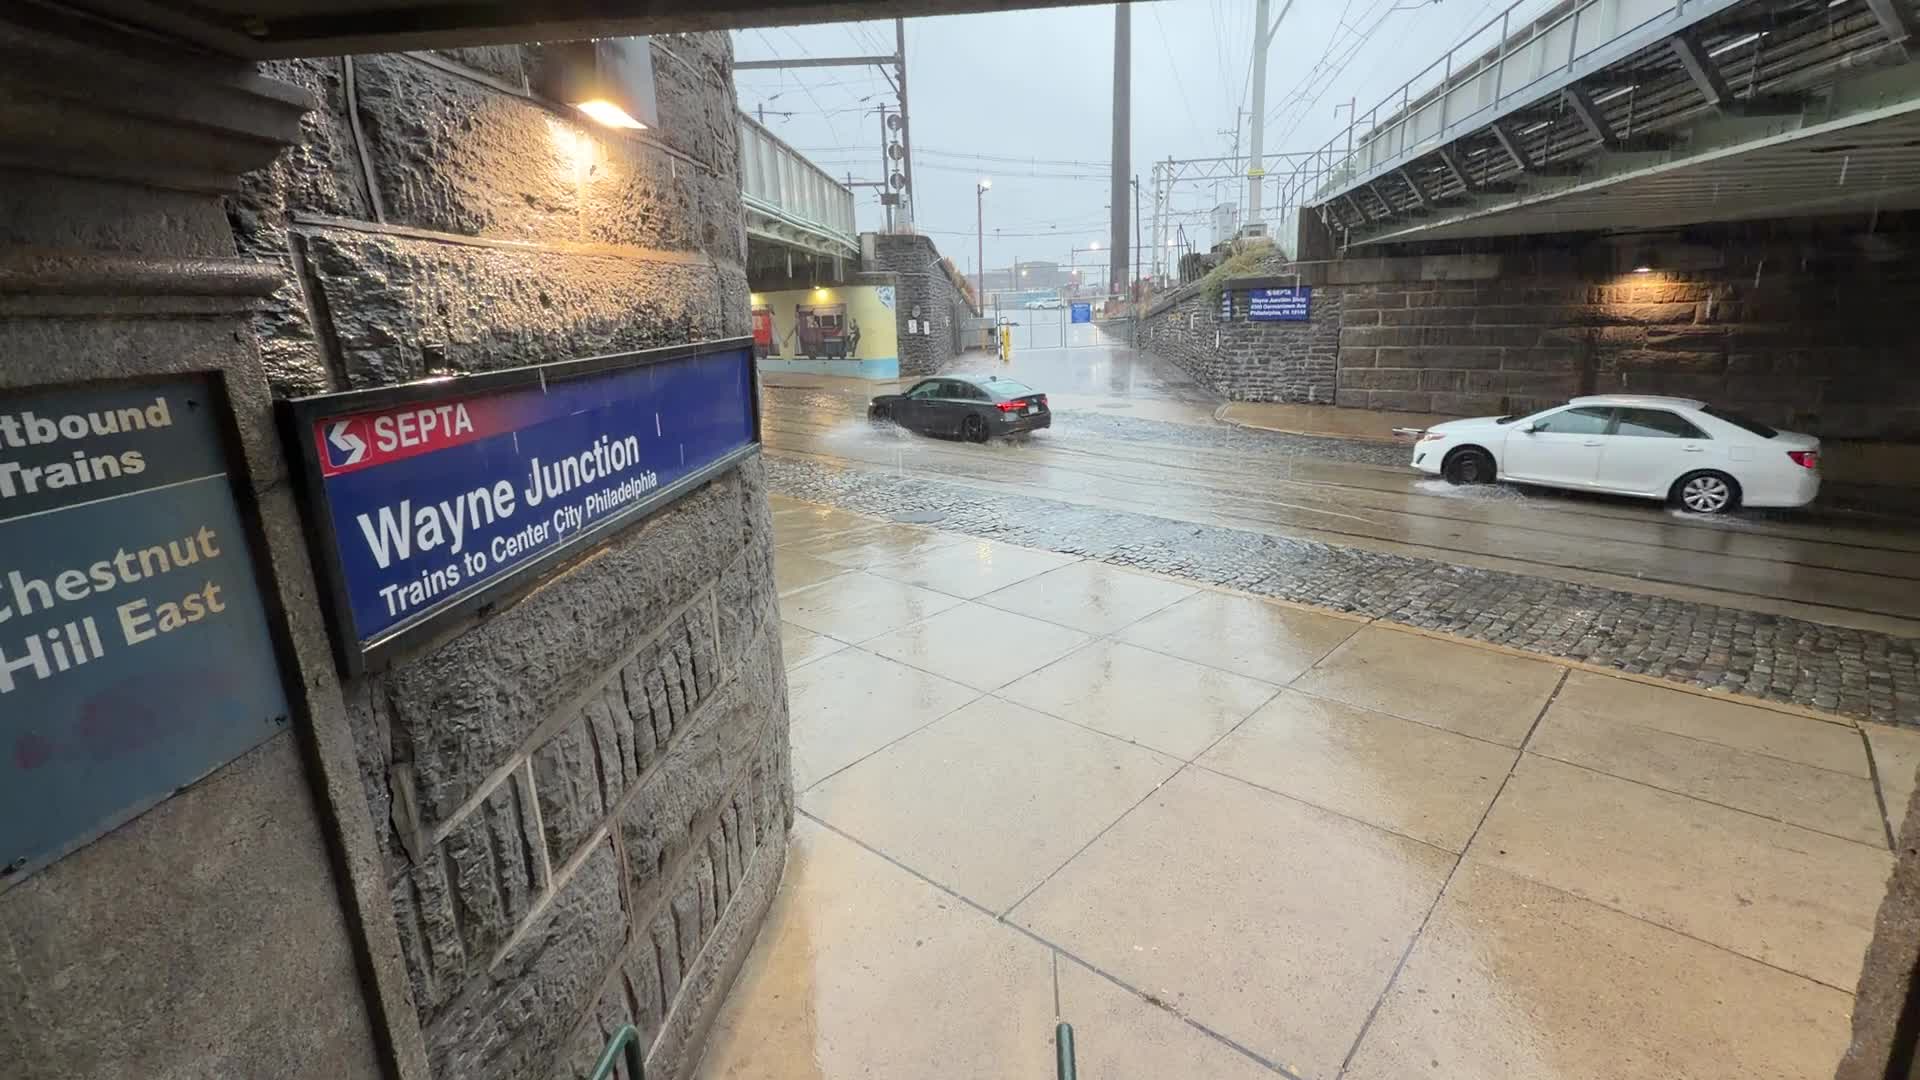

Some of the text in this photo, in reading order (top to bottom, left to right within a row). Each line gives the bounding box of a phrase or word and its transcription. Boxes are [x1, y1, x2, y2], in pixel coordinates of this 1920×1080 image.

[0, 397, 173, 450] tbound
[374, 402, 474, 453] SEPTA
[0, 448, 147, 498] Trains
[357, 434, 640, 570] Wayne Junction
[0, 525, 221, 623] hestnut
[379, 468, 659, 617] Trains to Center City Philadelphia
[0, 573, 226, 692] Hill East
